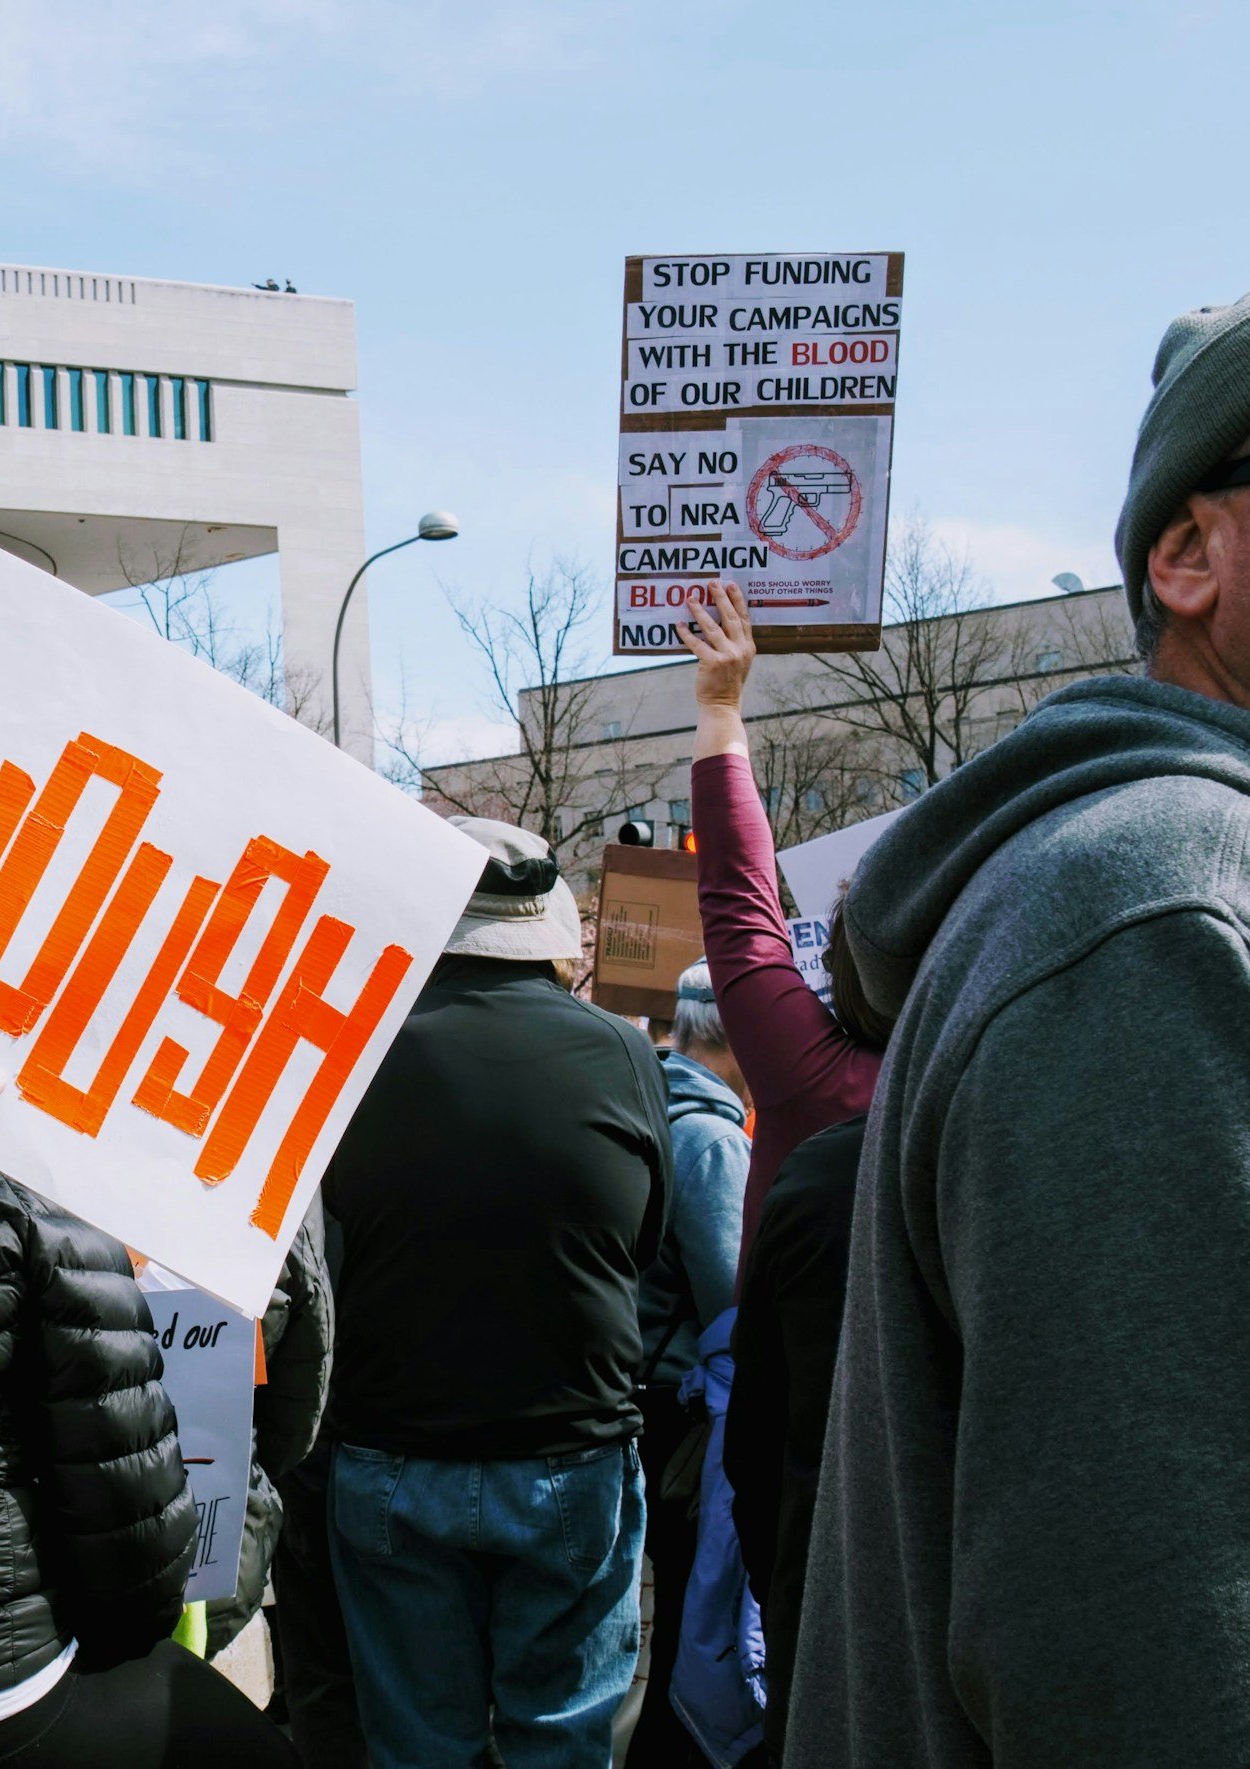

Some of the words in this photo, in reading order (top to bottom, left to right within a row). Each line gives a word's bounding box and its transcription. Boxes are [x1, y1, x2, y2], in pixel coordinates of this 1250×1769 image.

[653, 261, 730, 287] STOP
[745, 260, 871, 286] FUNDING
[638, 304, 718, 329] YOUR
[729, 303, 900, 332] CAMPAIGNS
[639, 345, 711, 369] WITH
[723, 341, 778, 366] THE
[791, 339, 889, 366] BLOOD
[629, 382, 667, 407] OF
[681, 381, 741, 405] OUR
[756, 375, 896, 401] CHILDREN
[628, 452, 687, 476] SAY
[698, 451, 738, 474] NO
[629, 505, 667, 528] TO
[680, 502, 740, 526] NRA
[619, 546, 768, 572] CAMPAIGN
[768, 580, 800, 588] SHOULD
[183, 1320, 228, 1350] our
